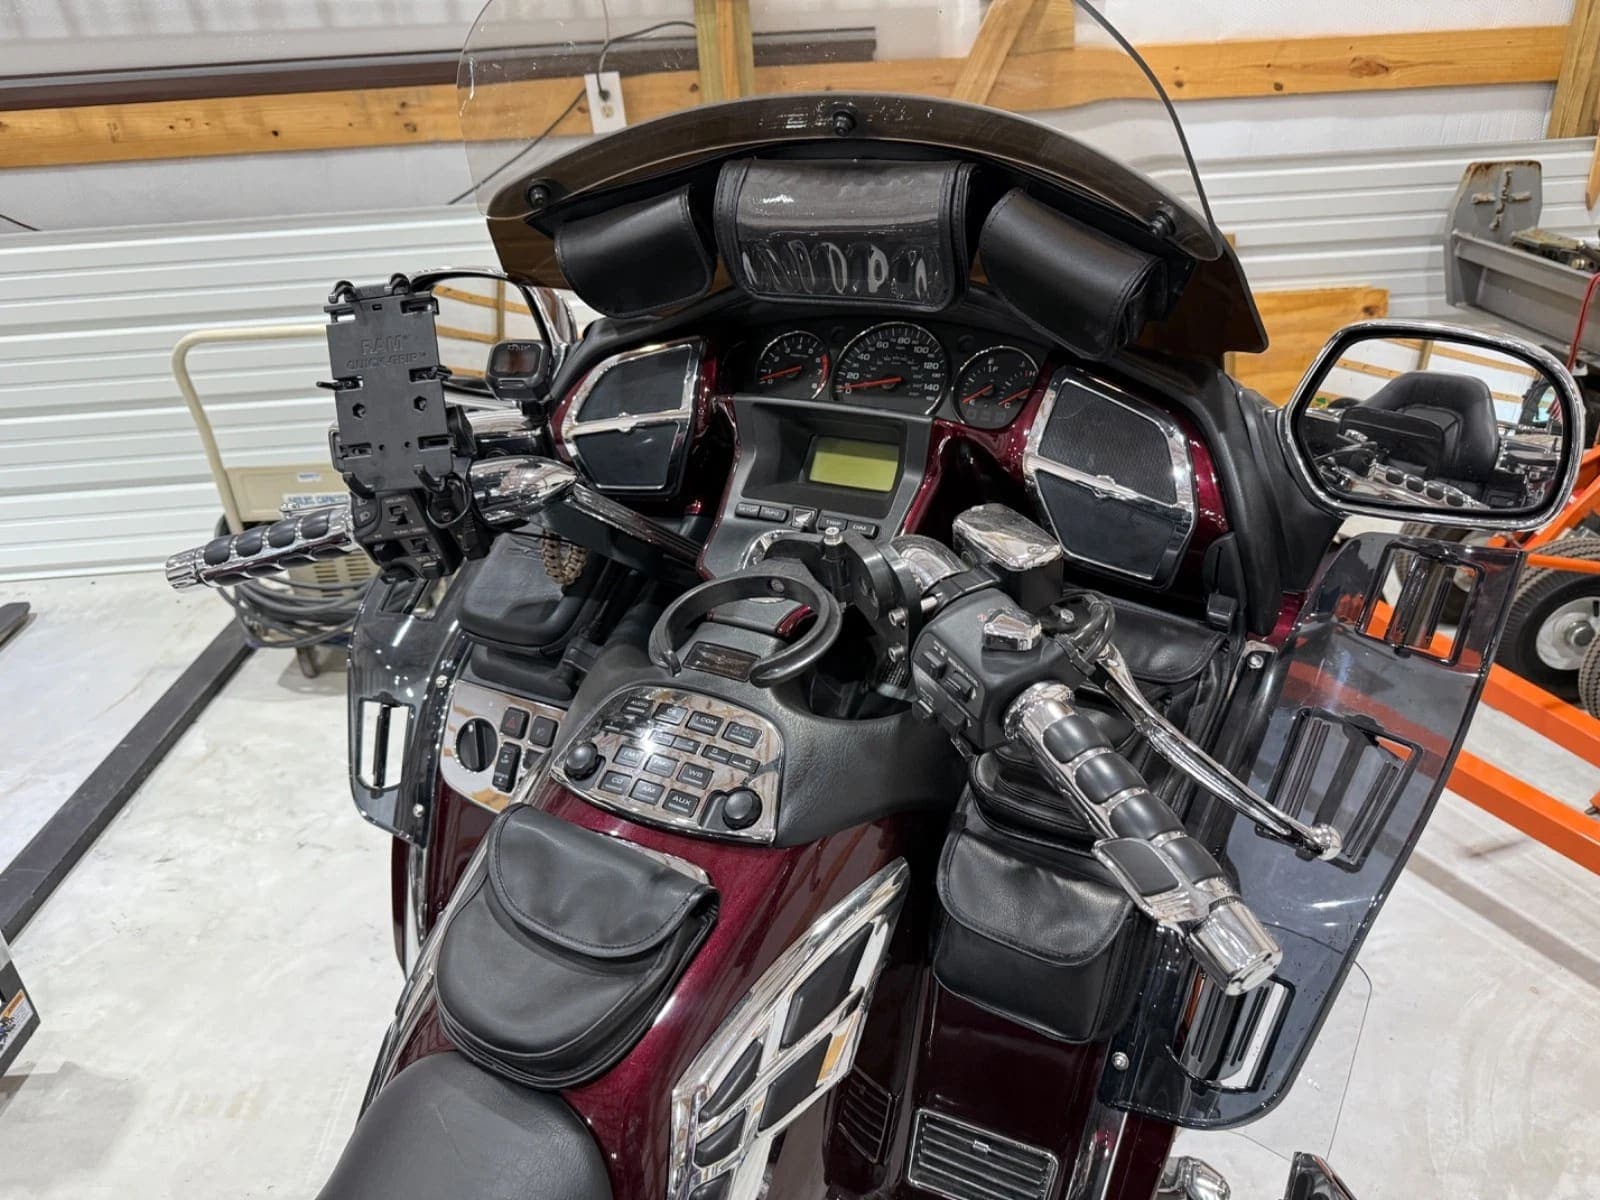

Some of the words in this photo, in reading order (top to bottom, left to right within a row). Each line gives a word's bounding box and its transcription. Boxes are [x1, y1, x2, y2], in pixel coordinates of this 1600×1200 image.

[361, 335, 403, 354] RAM
[611, 776, 624, 784] CD
[672, 795, 691, 806] AUX
